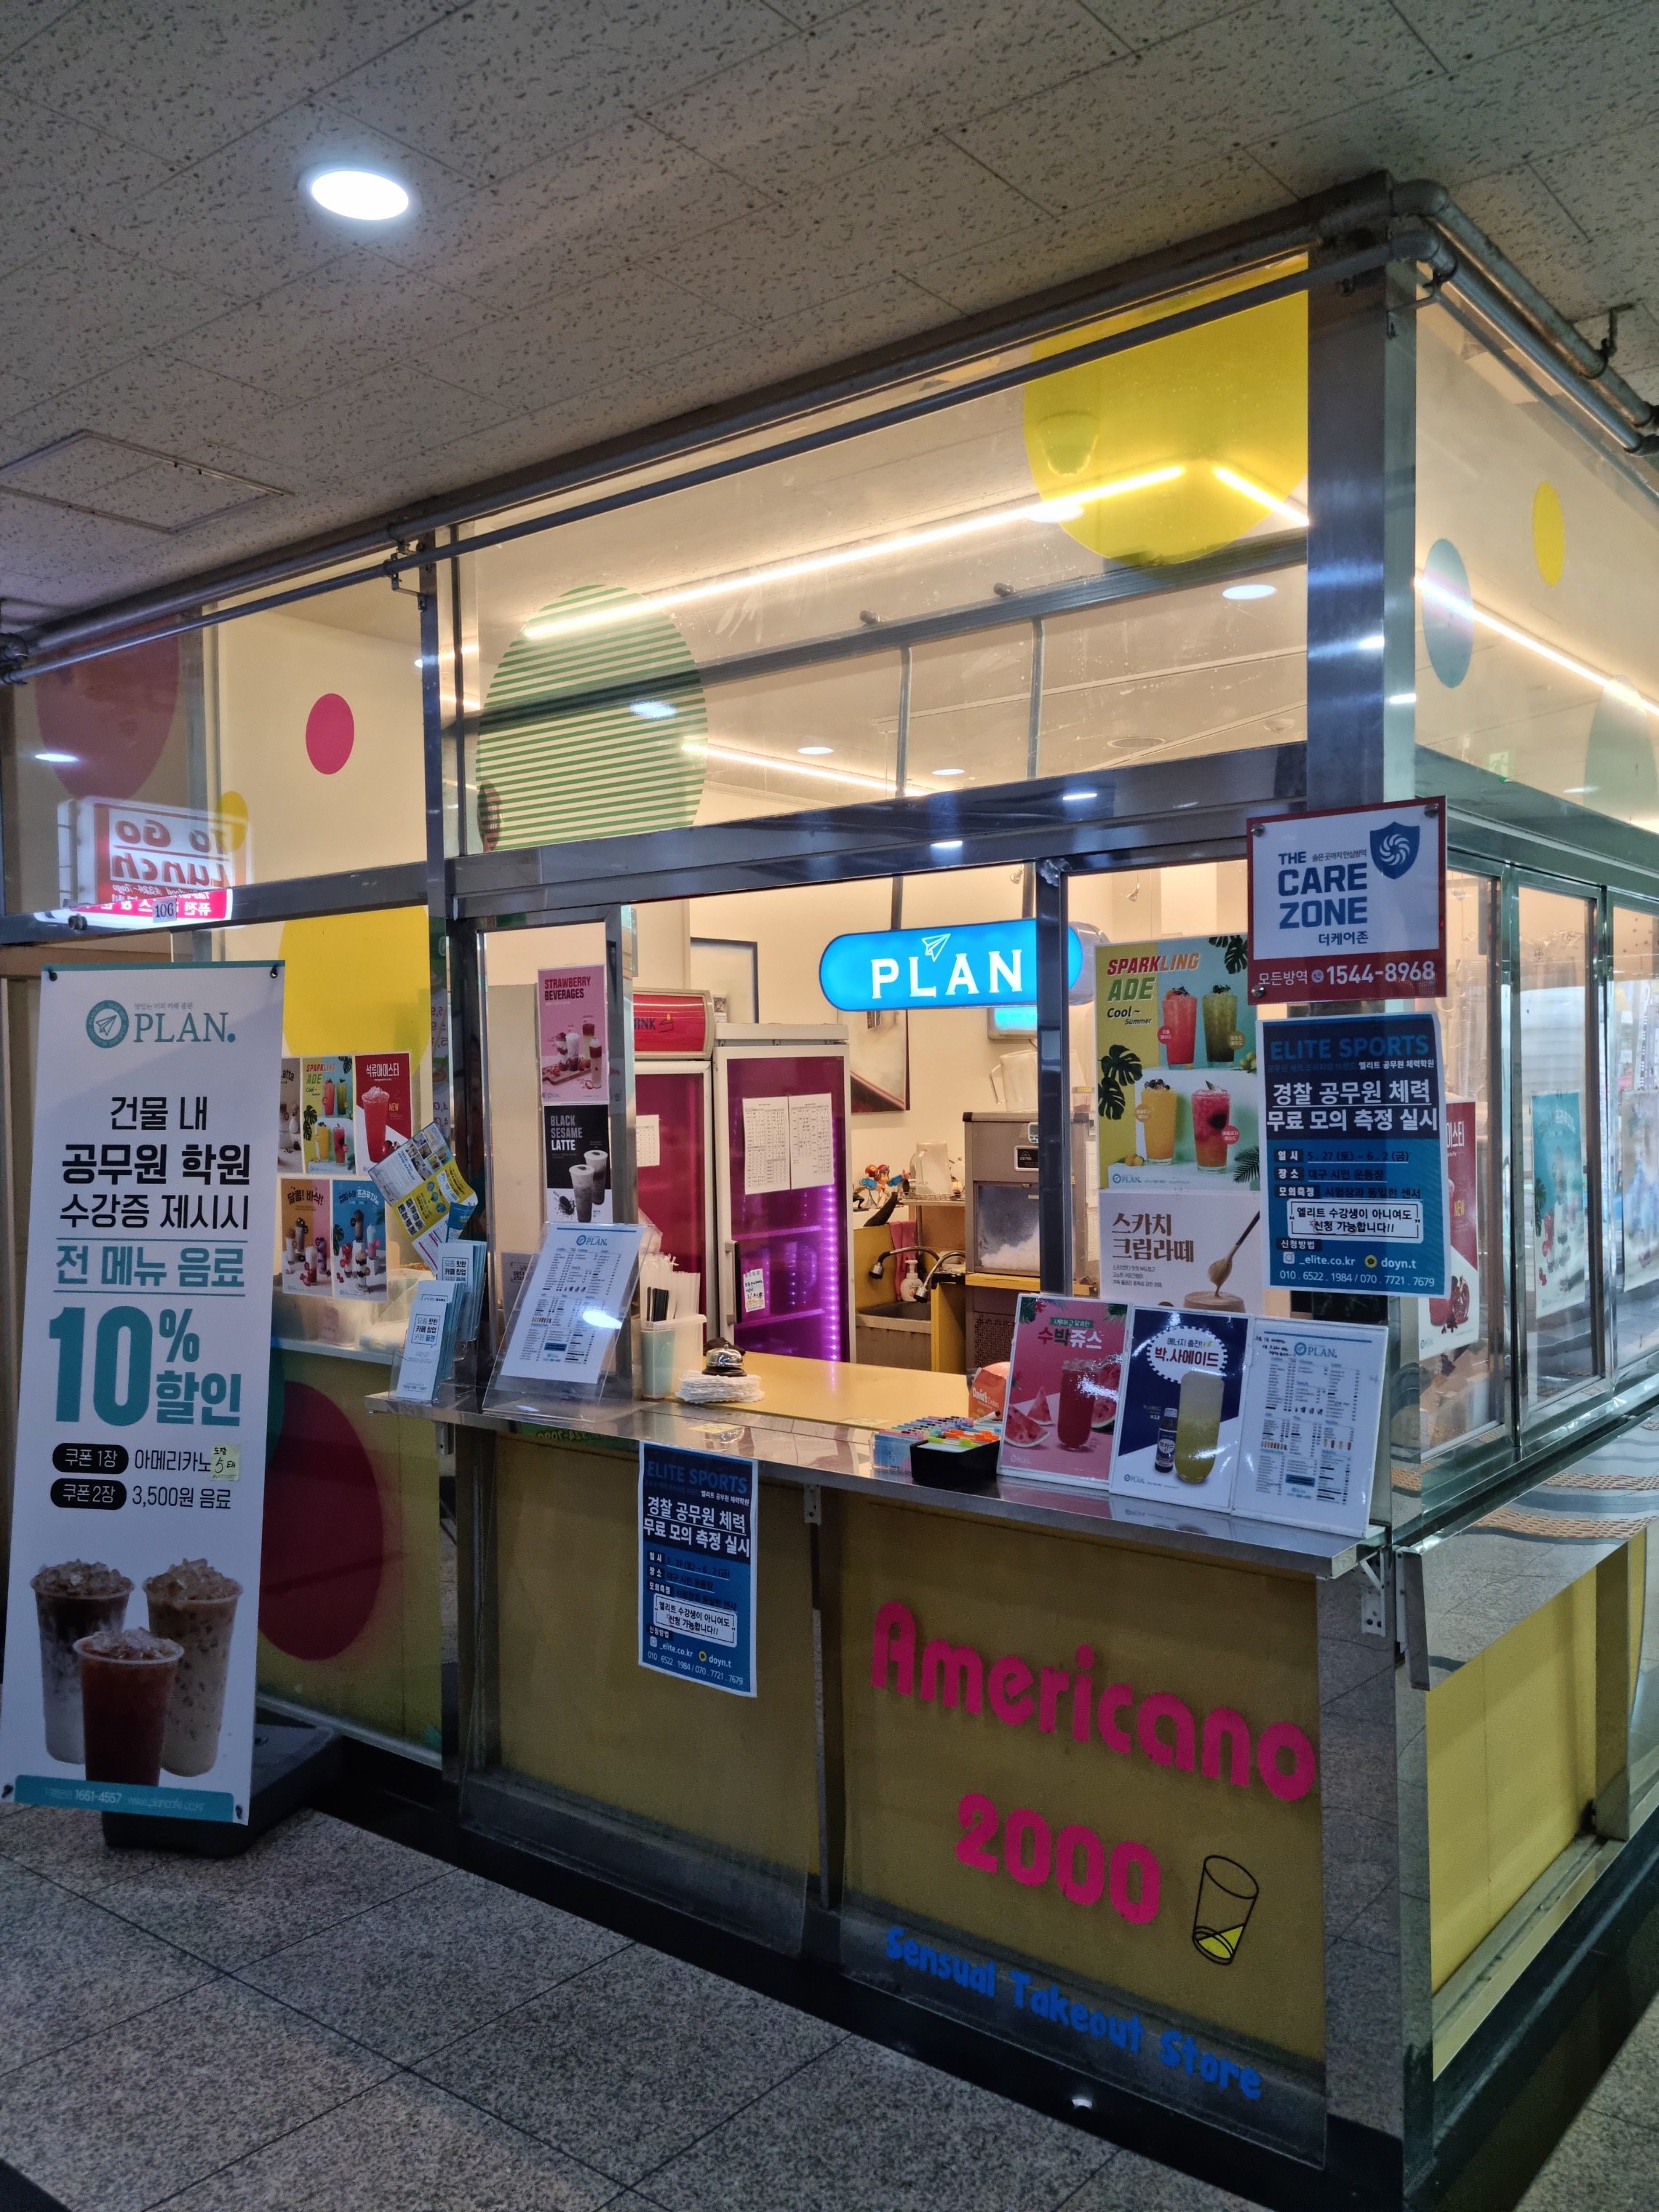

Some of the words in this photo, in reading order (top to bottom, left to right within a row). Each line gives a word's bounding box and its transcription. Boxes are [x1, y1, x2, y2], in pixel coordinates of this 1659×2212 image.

[1278, 851, 1307, 865] THE
[1278, 862, 1368, 896] CARE
[154, 902, 174, 918] 106
[1278, 896, 1368, 930] ZONE
[1318, 931, 1369, 947] 더케어존
[870, 949, 1023, 1000] PLAN
[1107, 952, 1201, 976] SPARKLING
[1258, 969, 1308, 986] 모든방역
[1326, 960, 1436, 985] 1544-8968
[544, 976, 591, 990] STRAWBERRY
[544, 987, 584, 1001] BEVERAGES
[1107, 976, 1158, 1003] ADE
[1106, 1006, 1132, 1019] Cool
[1124, 1017, 1153, 1025] Summer
[133, 1012, 236, 1043] PLAN.
[1270, 1038, 1332, 1061] ELITE
[1338, 1033, 1430, 1059] SPORTS
[281, 1068, 295, 1082] atta
[365, 1062, 399, 1078] 석류아이스티
[1358, 1061, 1381, 1070] 엘리트
[1382, 1060, 1404, 1070] 공무원
[1406, 1059, 1435, 1069] 체력학원
[306, 1073, 322, 1085] ADE
[1273, 1082, 1313, 1106] 경찰
[1318, 1080, 1382, 1105] 공무원
[1388, 1078, 1430, 1104] 체력
[110, 1096, 169, 1131] 건물
[179, 1096, 208, 1131] 내
[389, 1102, 399, 1112] NEW
[550, 1115, 576, 1127] BLACK
[1266, 1110, 1304, 1132] 무료
[1309, 1109, 1347, 1131] 모의
[1353, 1108, 1393, 1131] 측정
[1399, 1107, 1438, 1131] 실시
[550, 1127, 583, 1139] SESAME
[551, 1139, 576, 1151] LATTE
[62, 1143, 167, 1185] 공무원
[181, 1144, 250, 1185] 학원
[1308, 1169, 1327, 1180] 대구
[59, 1193, 150, 1229] 수강증
[159, 1194, 248, 1230] 제시시
[1296, 1206, 1326, 1218] 엘리트
[1329, 1208, 1369, 1220] 수강생이
[1372, 1209, 1412, 1220] 아니여도
[1111, 1212, 1171, 1237] 스카치
[1314, 1220, 1334, 1232] 신청
[585, 1236, 608, 1246] PLAN.
[1112, 1238, 1194, 1263] 크림라떼
[1281, 1238, 1316, 1250] 신청방법
[55, 1245, 88, 1285] 전
[101, 1245, 167, 1286] 메뉴
[177, 1247, 245, 1288] 음료
[1381, 1257, 1417, 1271] doyn.t
[1037, 1326, 1102, 1350] 수박쥬스
[1166, 1337, 1187, 1347] 에너지
[1308, 1346, 1337, 1358] PLAN.
[156, 1370, 242, 1427] 할인
[64, 1448, 92, 1468] 쿠폰
[97, 1449, 118, 1468] 1장
[134, 1449, 212, 1472] 아메리카노
[215, 1456, 223, 1473] 5
[647, 1460, 685, 1482] ELITE
[688, 1467, 748, 1495] SPORTS
[132, 1485, 195, 1508] 3,500원
[199, 1488, 232, 1510] 음료
[648, 1496, 673, 1519] 경찰
[675, 1502, 715, 1528] 공무원
[719, 1511, 746, 1534] 체력
[643, 1517, 667, 1537] 무료
[669, 1524, 692, 1546] 모의
[696, 1529, 721, 1551] 측정
[725, 1535, 750, 1558] 실시
[659, 1601, 677, 1613] 엘리트
[677, 1606, 703, 1620] 수강생이
[704, 1613, 731, 1628] 아니여도
[709, 1654, 732, 1668] doyn.t
[870, 1600, 1316, 1801] Americano
[955, 1792, 1161, 1925] 2000
[886, 1926, 996, 1997] Sensual
[1009, 1969, 1144, 2054] Takeout
[1159, 2029, 1262, 2100] Store
